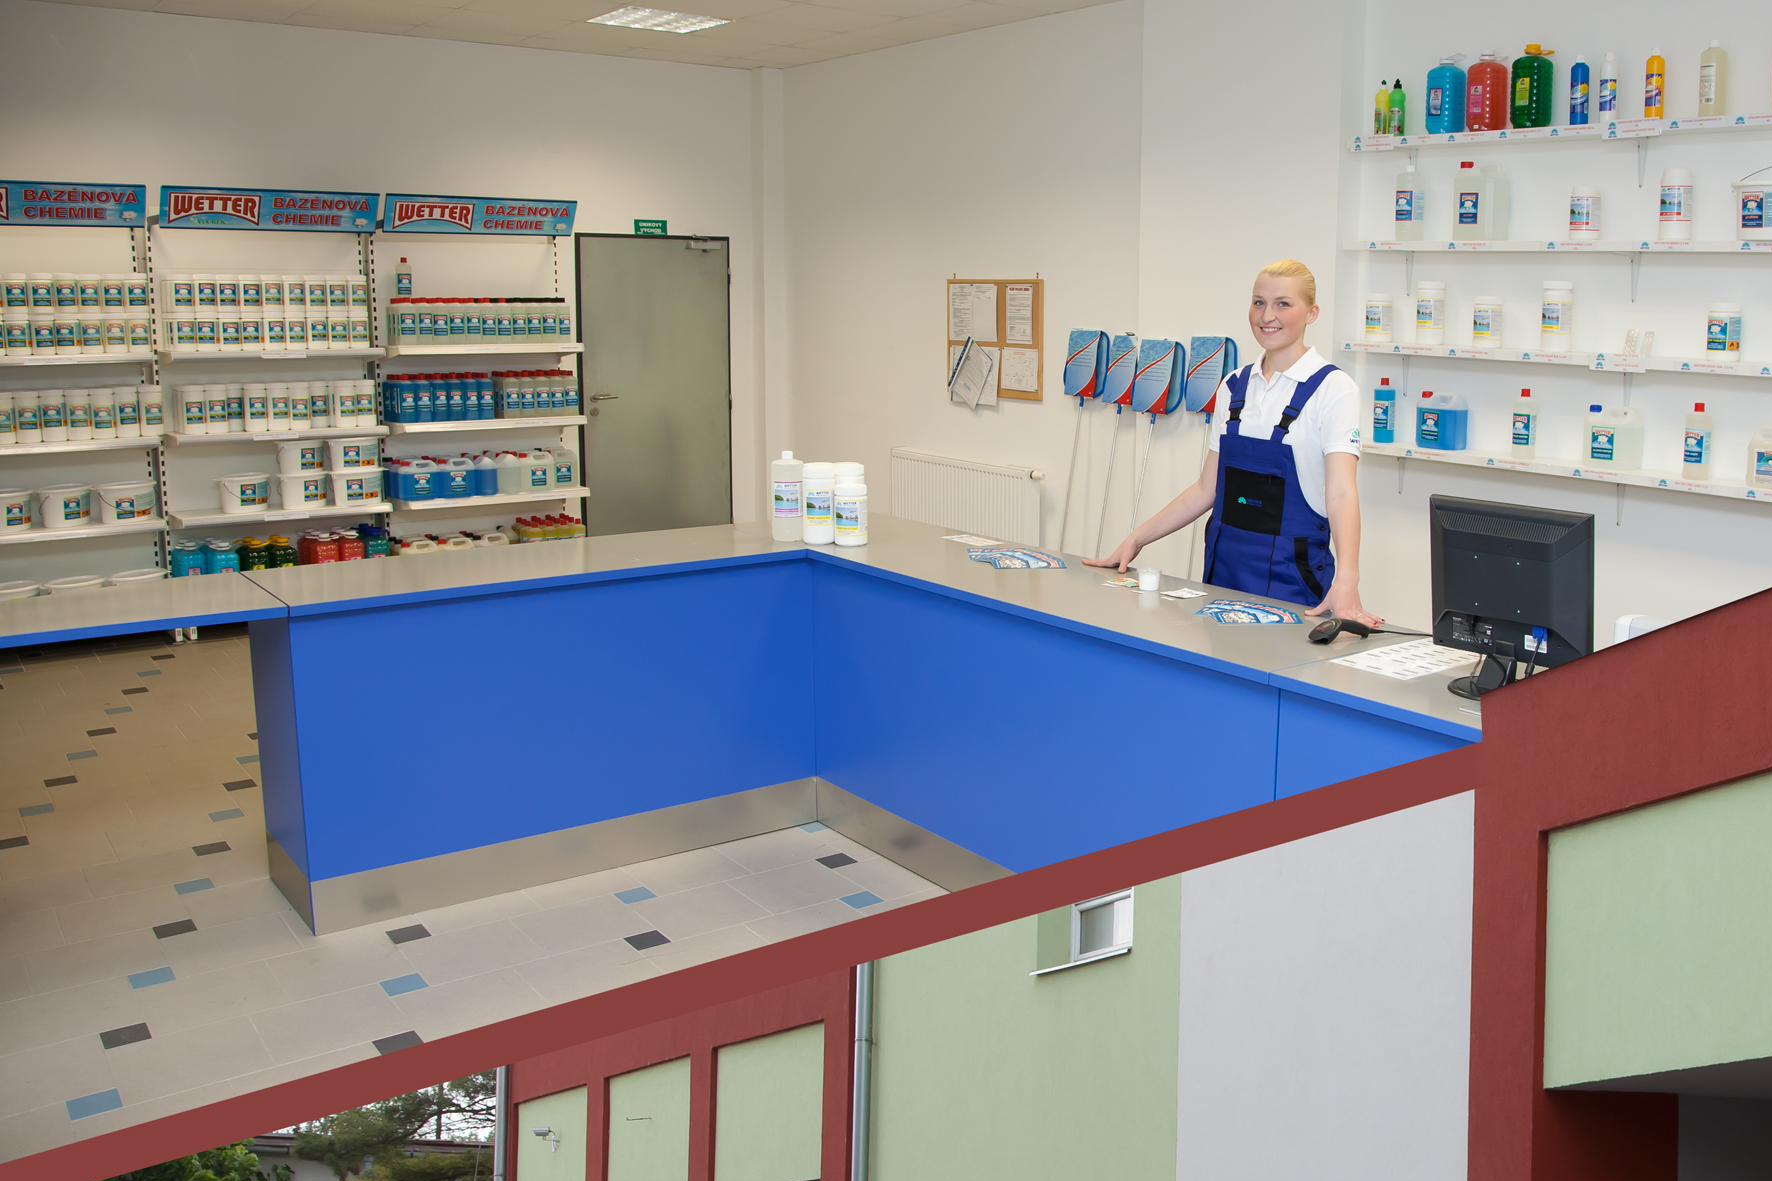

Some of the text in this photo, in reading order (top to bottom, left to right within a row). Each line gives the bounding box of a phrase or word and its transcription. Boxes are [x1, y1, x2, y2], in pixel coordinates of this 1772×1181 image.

[23, 188, 139, 204] BAZÉNOVÁ
[173, 195, 257, 218] WETTER
[272, 196, 370, 212] BAZÉNOVÁ
[484, 203, 569, 218] BAZÉNOVÁ
[23, 205, 106, 219] CHEMIE
[271, 212, 341, 226] CHEMIE
[397, 203, 472, 224] WETTER
[483, 218, 543, 230] CHEMIE
